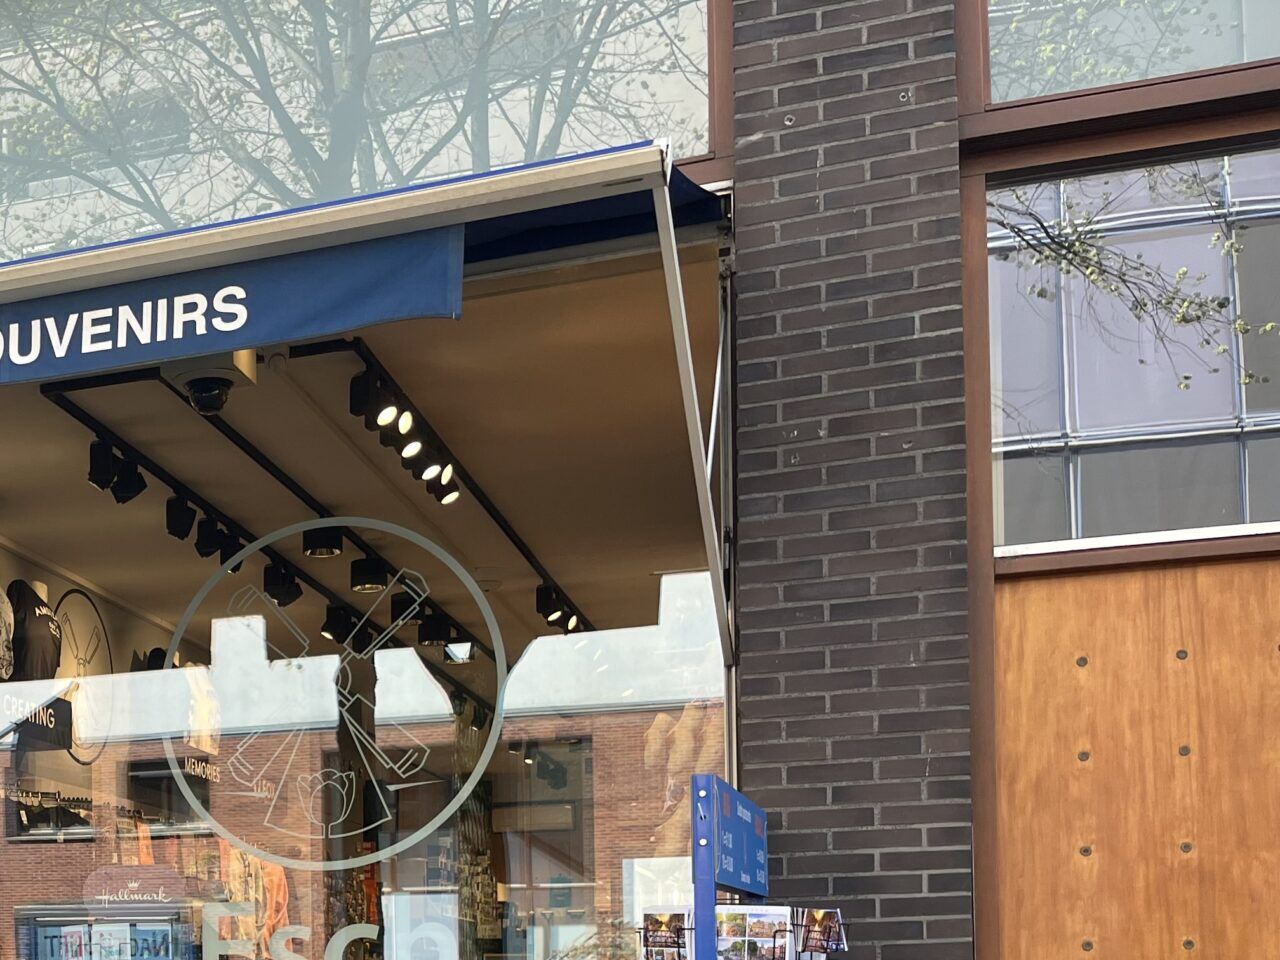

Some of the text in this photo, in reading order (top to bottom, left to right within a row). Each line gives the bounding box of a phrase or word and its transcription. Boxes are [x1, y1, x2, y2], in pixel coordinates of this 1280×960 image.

[3, 694, 55, 728] CREATING
[184, 756, 220, 782] MEMORIES
[95, 886, 173, 908] Hallmark
